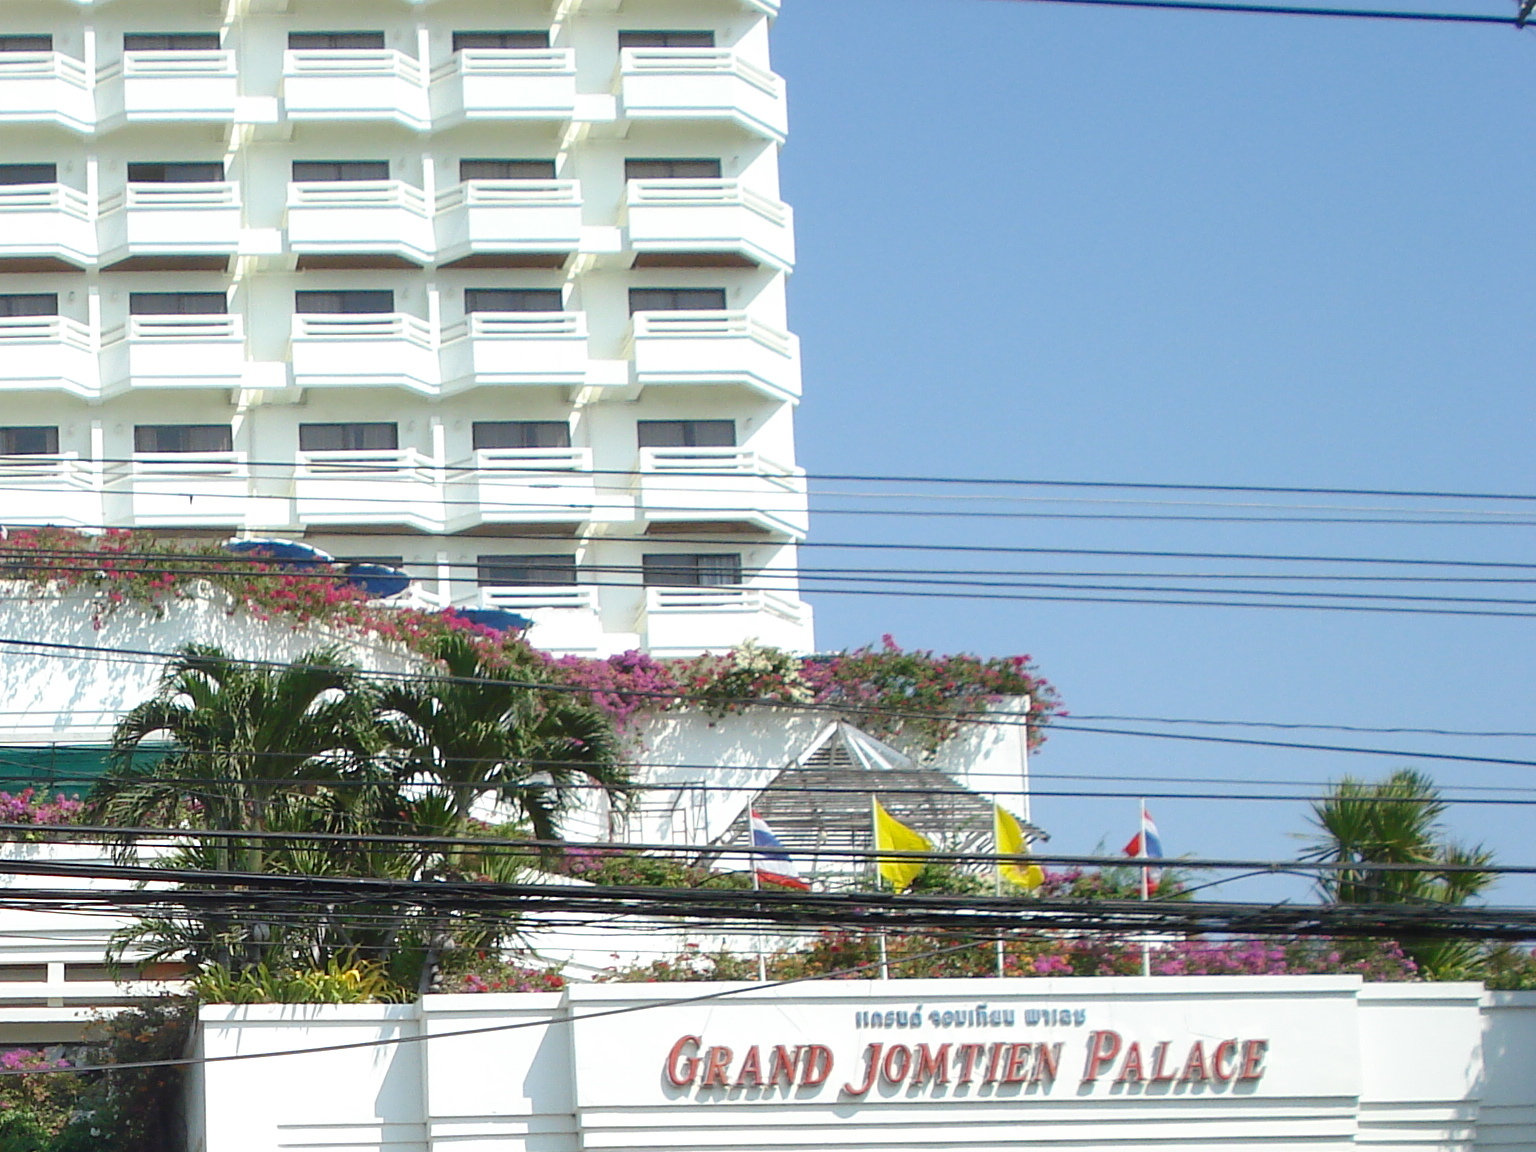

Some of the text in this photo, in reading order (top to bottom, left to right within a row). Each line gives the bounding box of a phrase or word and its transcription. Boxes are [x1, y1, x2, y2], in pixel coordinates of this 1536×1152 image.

[666, 1029, 1269, 1096] GRAND JOMTIEN PALACE
